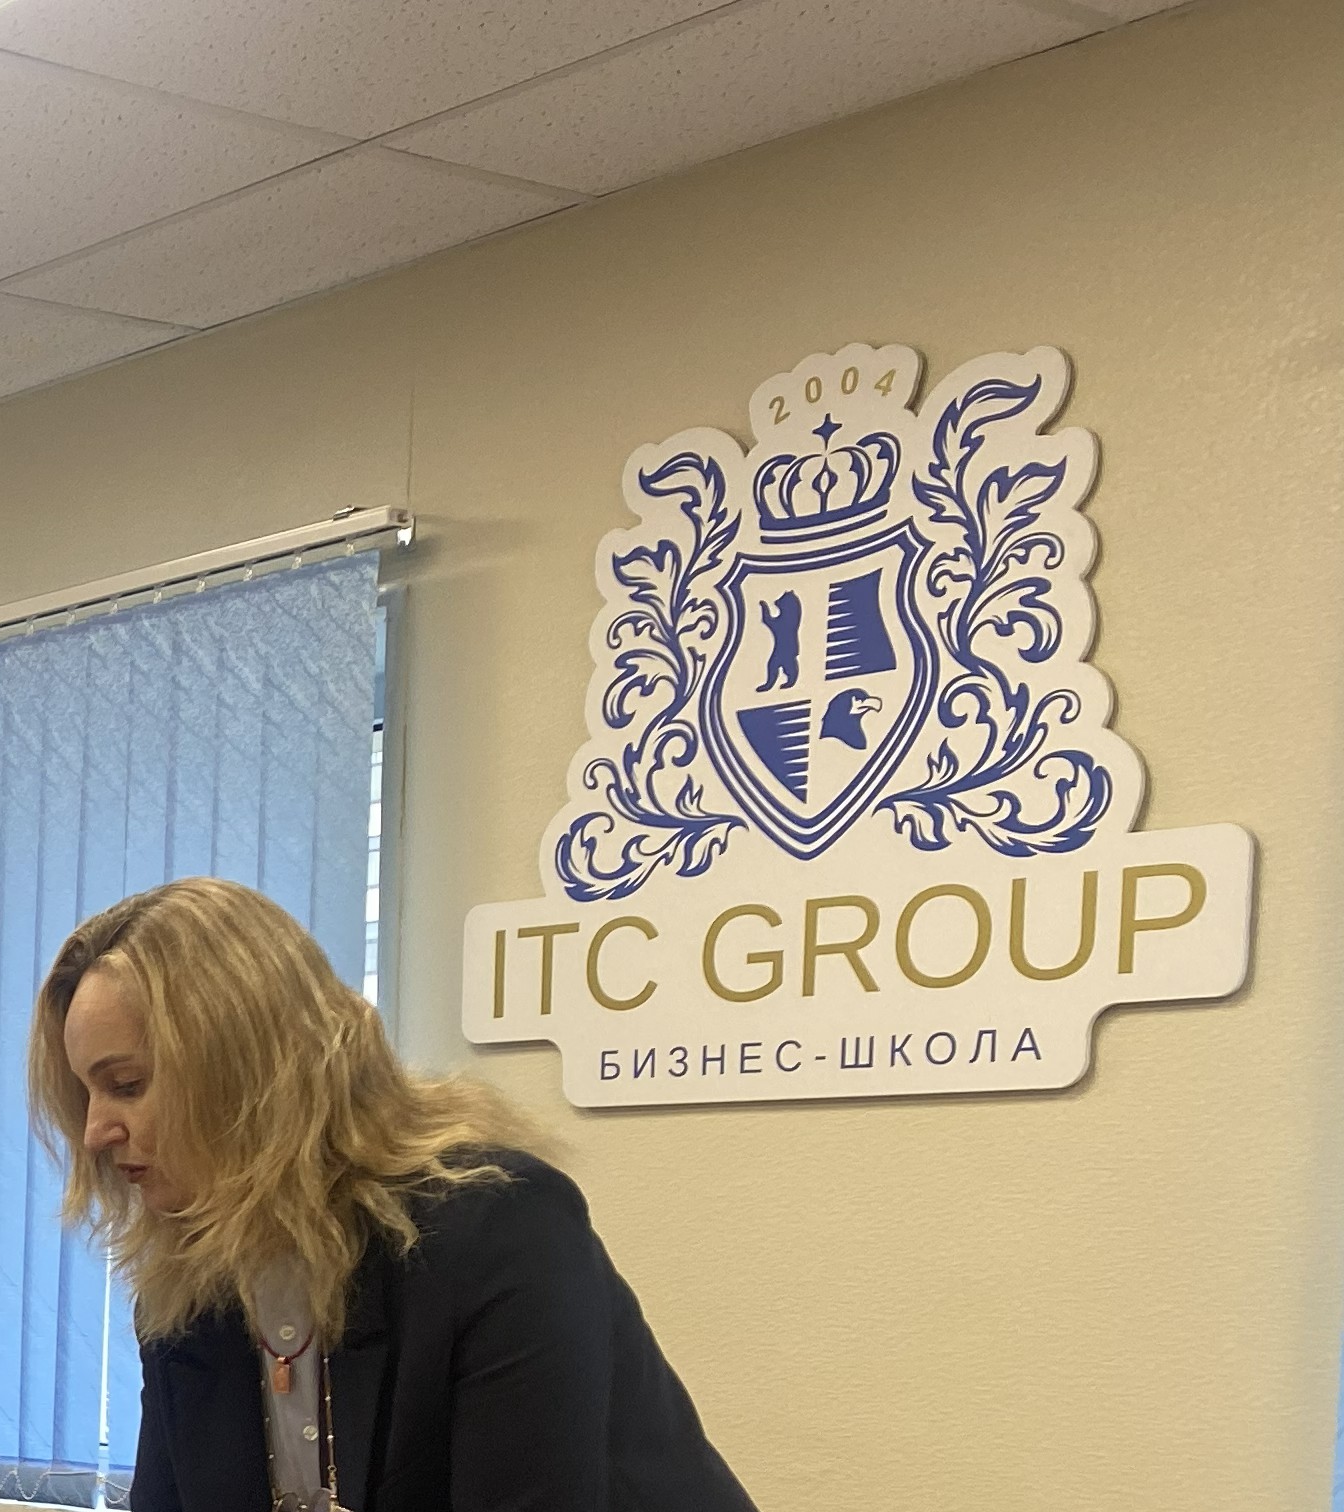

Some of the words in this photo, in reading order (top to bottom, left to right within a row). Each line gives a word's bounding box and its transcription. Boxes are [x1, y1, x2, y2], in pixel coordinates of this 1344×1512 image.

[768, 366, 897, 425] 2004
[491, 915, 660, 1019] ITC
[701, 862, 1208, 1003] GROUP
[598, 1028, 1043, 1082] БИЗНЕС-ШКОЛА
